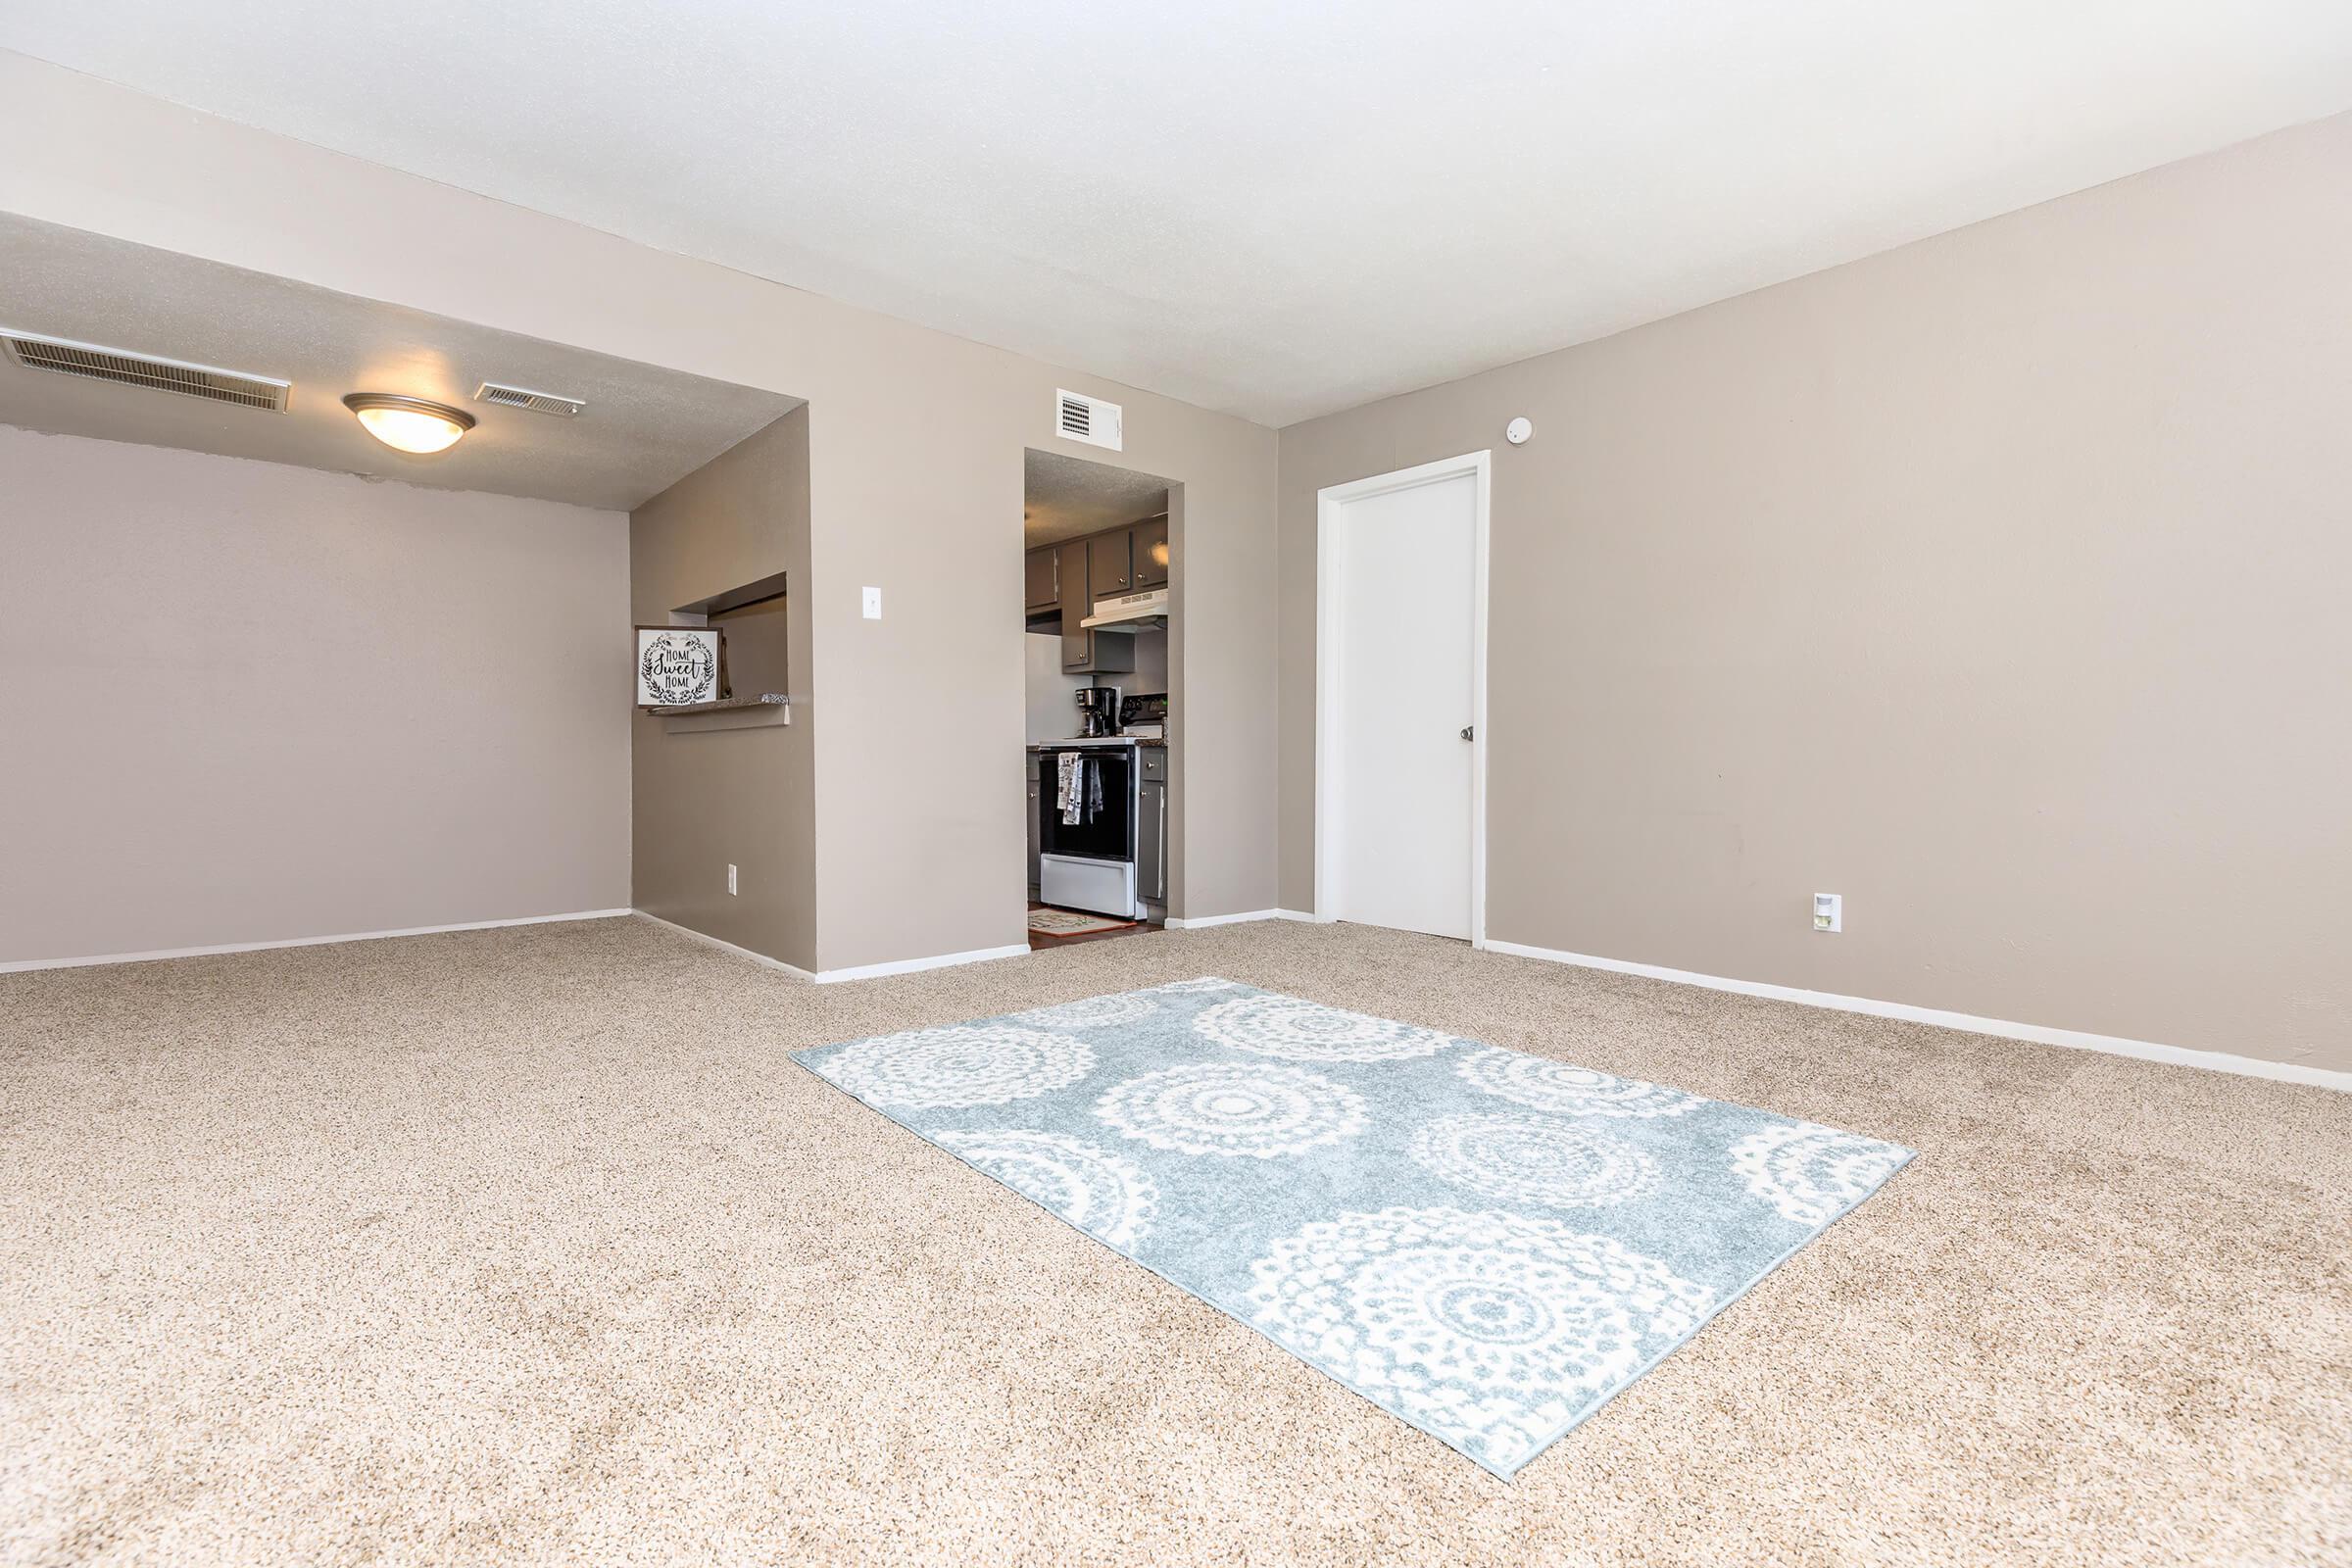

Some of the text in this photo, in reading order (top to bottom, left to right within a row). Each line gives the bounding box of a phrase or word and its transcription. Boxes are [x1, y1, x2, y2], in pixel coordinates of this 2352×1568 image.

[666, 649, 690, 662] HOME
[653, 653, 706, 679] Sweet
[665, 675, 689, 688] HOME
